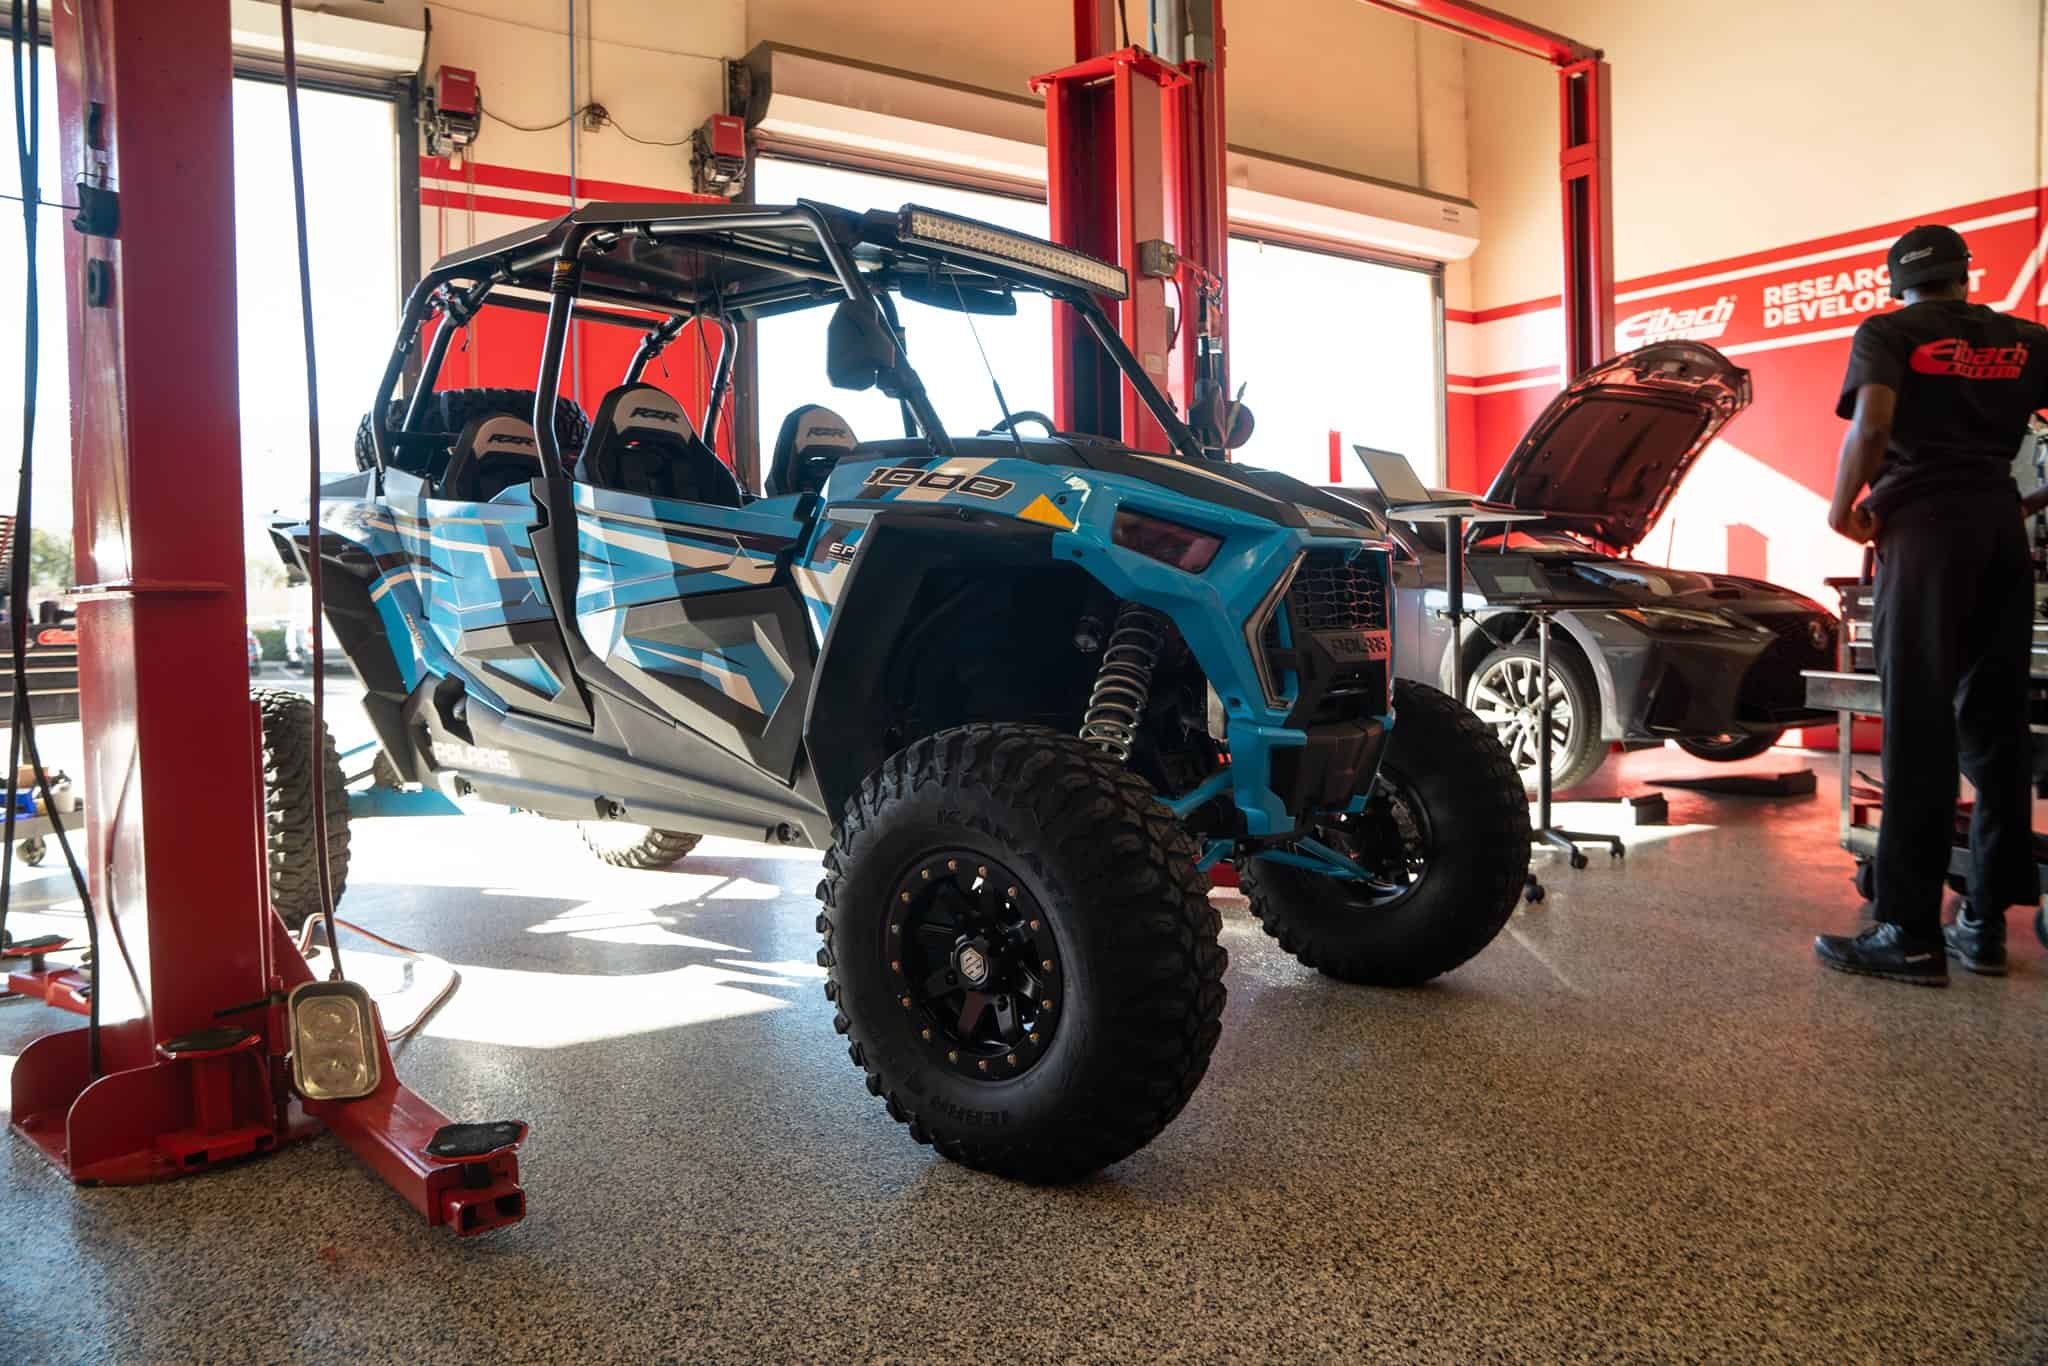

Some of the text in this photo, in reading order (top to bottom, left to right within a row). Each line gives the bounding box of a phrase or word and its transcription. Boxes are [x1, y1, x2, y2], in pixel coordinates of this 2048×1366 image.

[1763, 264, 1893, 307] RESEARC
[863, 466, 1016, 501] 1000
[432, 741, 513, 770] POLARIS
